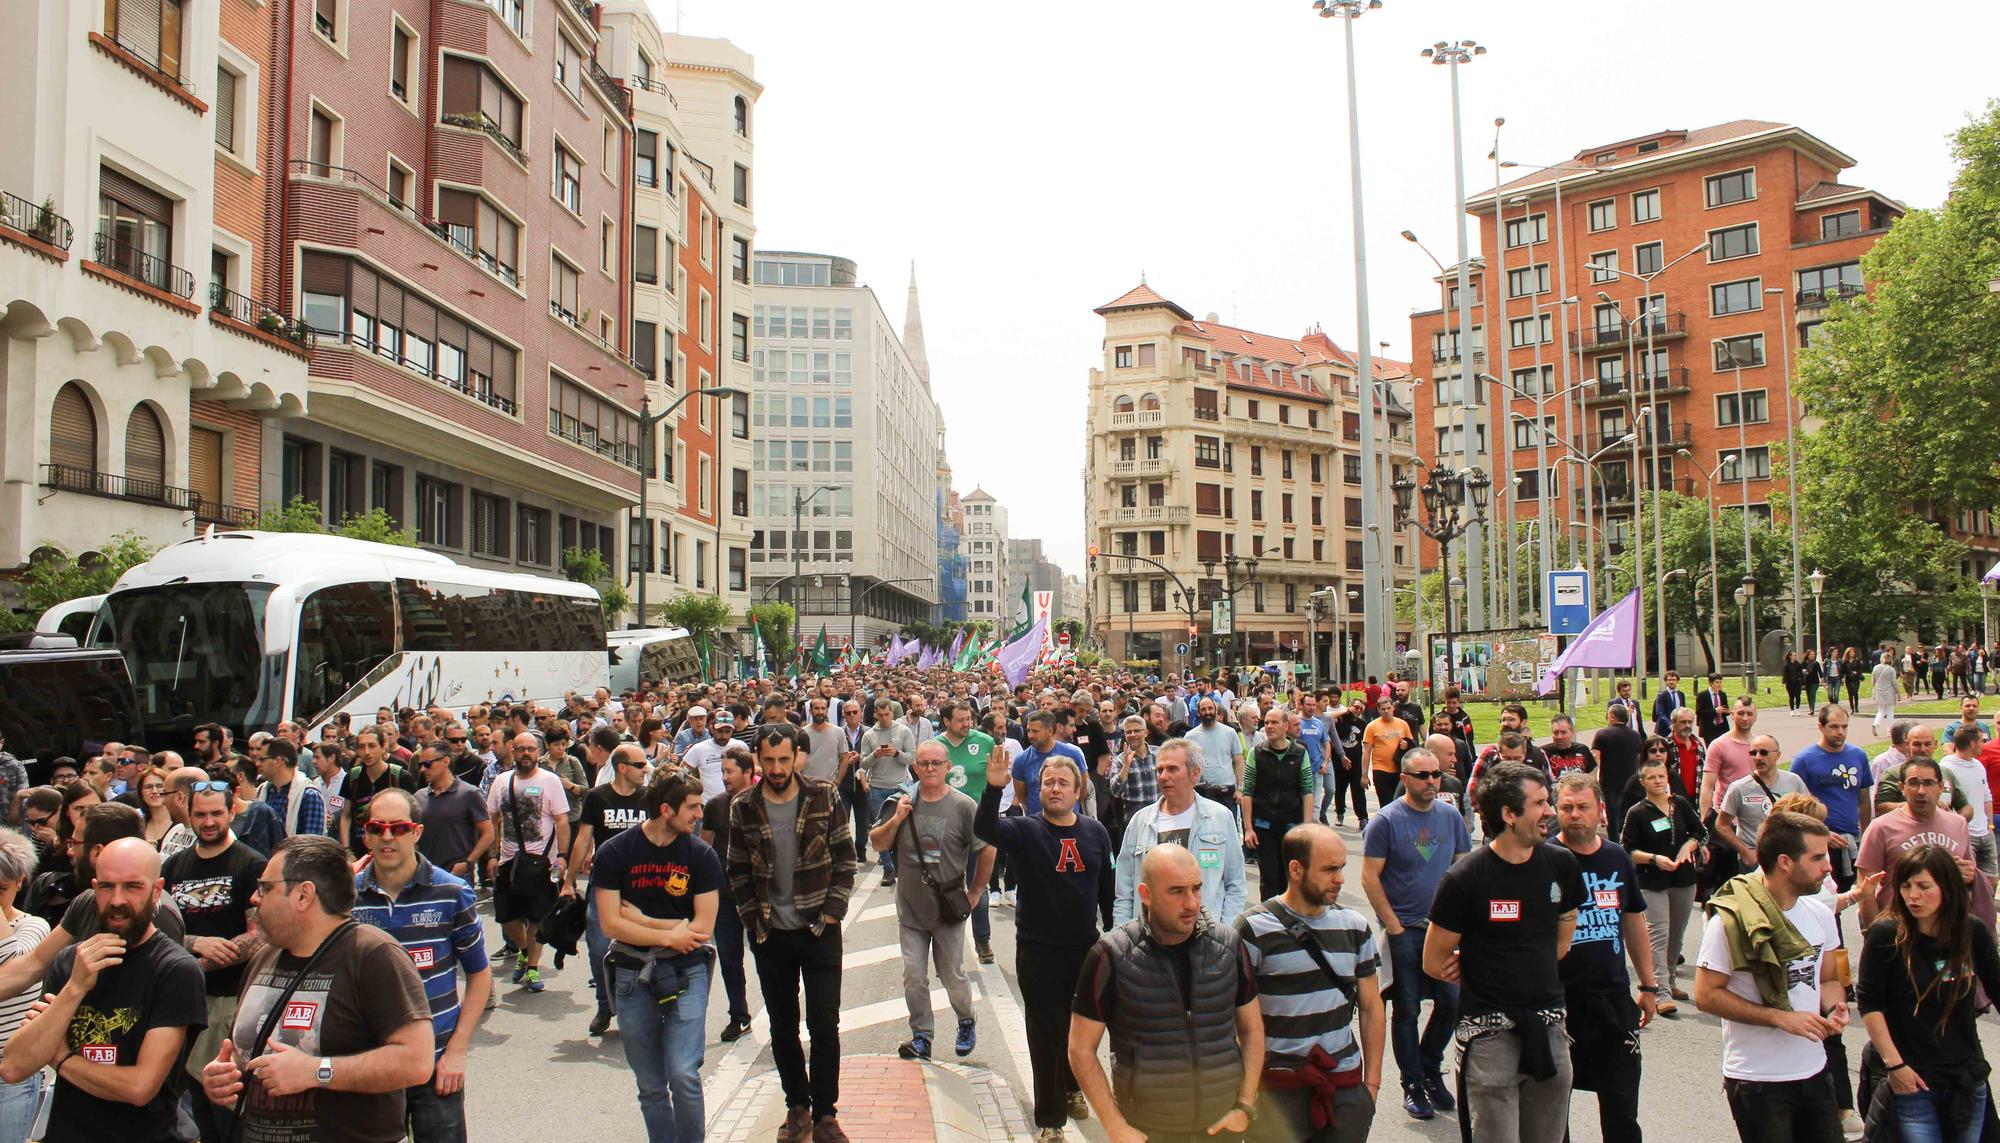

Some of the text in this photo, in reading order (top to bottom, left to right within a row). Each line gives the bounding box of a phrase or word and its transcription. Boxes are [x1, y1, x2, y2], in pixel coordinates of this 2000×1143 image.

[949, 765, 968, 788] 3
[603, 808, 647, 823] BALA
[1056, 838, 1085, 872] A
[1493, 904, 1517, 914] LAB
[414, 951, 432, 963] AB
[301, 979, 333, 991] FESTIVAL
[287, 1007, 312, 1020] LAB
[85, 1049, 114, 1062] LAB
